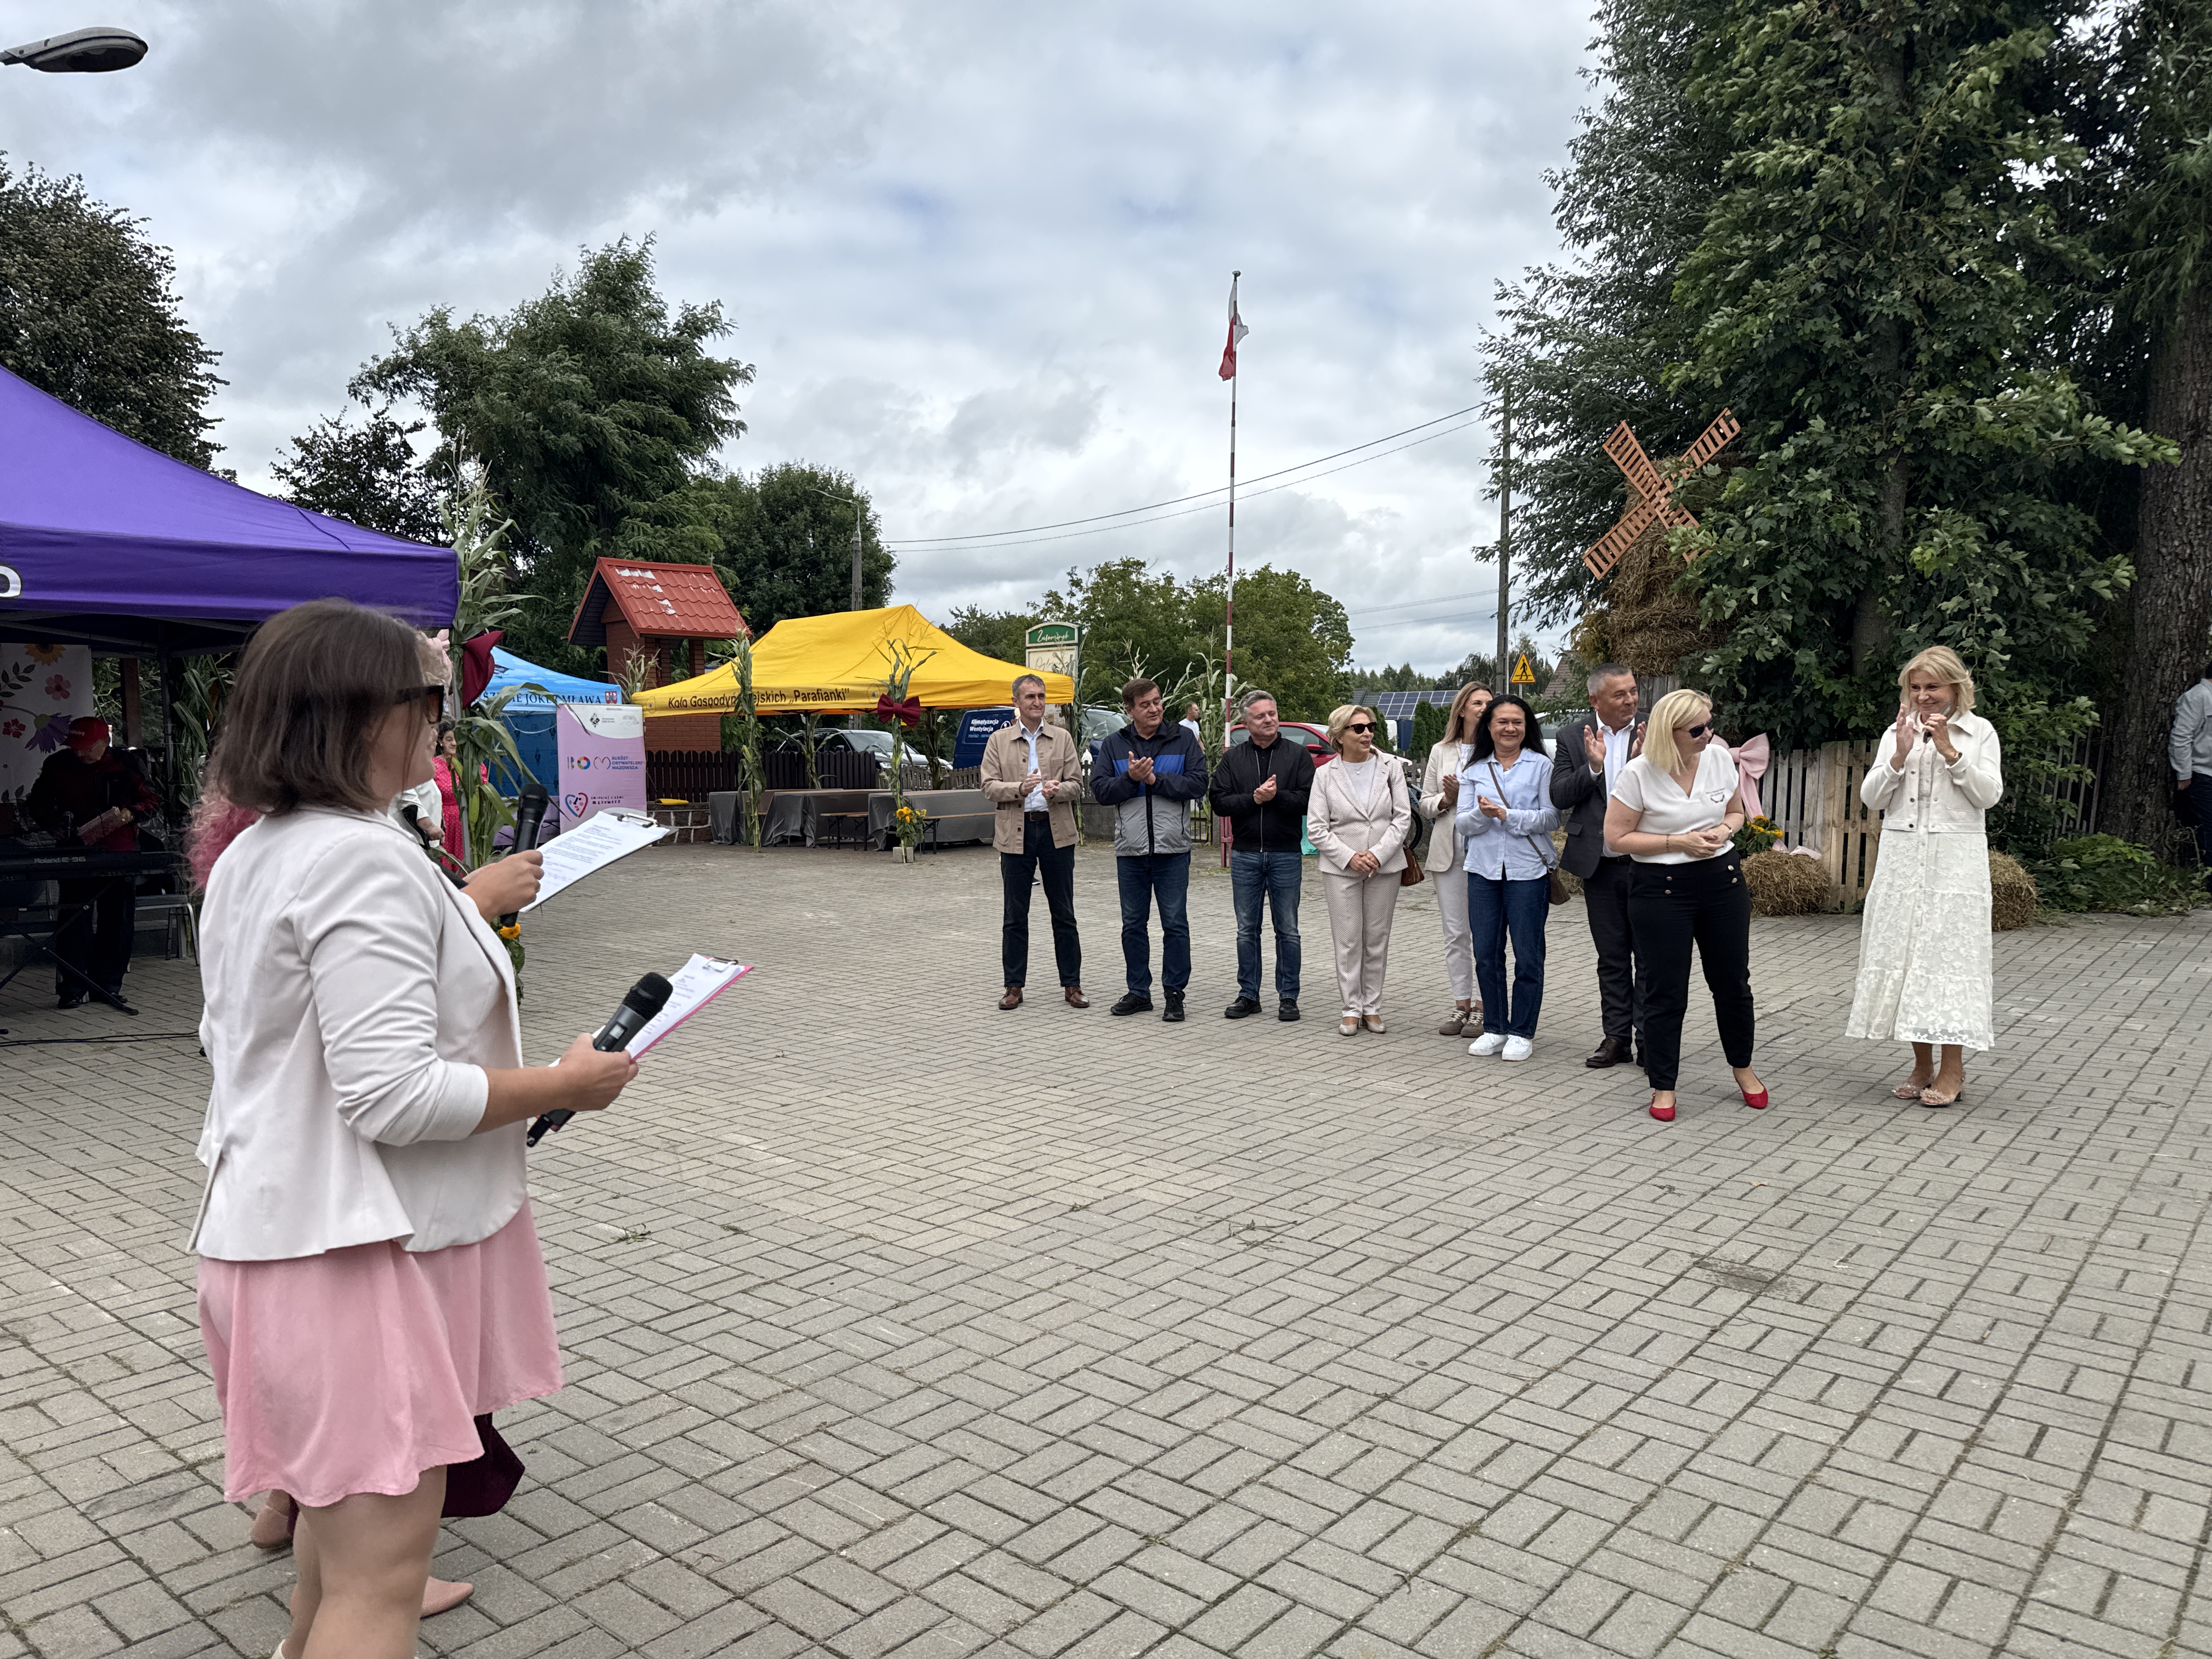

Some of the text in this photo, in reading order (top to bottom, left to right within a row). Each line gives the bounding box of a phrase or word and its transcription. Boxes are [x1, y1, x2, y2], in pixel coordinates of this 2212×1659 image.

[562, 695, 601, 704] MŁAWA
[690, 692, 736, 708] Gospodyń
[753, 690, 786, 706] ejskich
